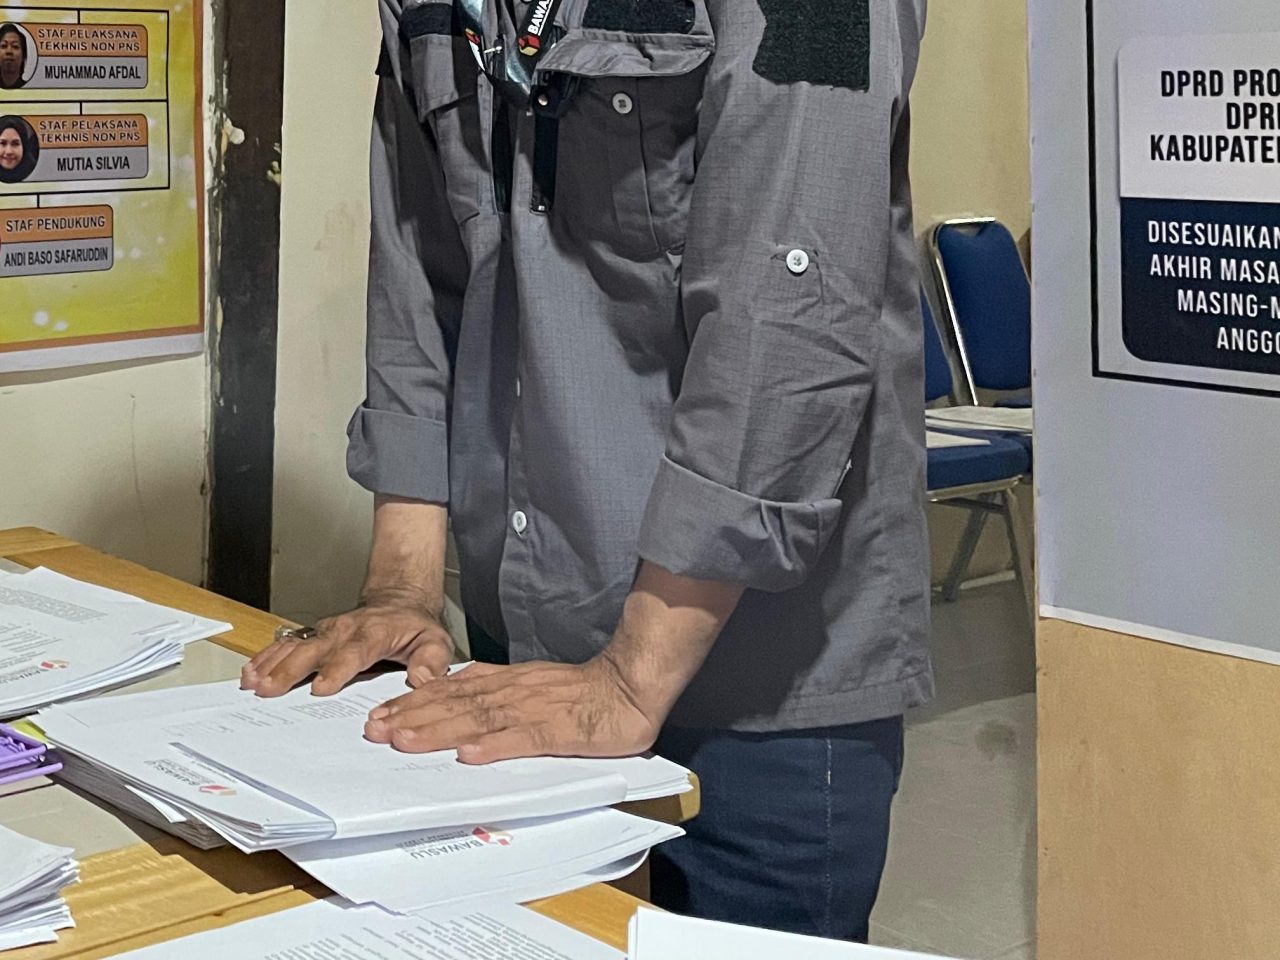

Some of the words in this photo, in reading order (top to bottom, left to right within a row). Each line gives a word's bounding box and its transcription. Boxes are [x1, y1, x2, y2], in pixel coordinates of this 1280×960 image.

[38, 28, 65, 39] STAF
[69, 29, 138, 39] PELAKSANA
[39, 41, 88, 51] TEKHNIS
[91, 42, 115, 51] NON
[118, 42, 140, 52] PNS
[44, 65, 107, 79] MUHAMMAD
[108, 65, 141, 79] AFDAL
[1161, 70, 1224, 98] DPRD
[1233, 68, 1280, 97] PRO
[39, 120, 67, 130] STAF
[71, 120, 138, 130] PELAKSANA
[40, 132, 89, 143] TEKHNIS
[92, 132, 116, 142] NON
[119, 131, 140, 141] PNS
[57, 157, 93, 171] MUTIA
[95, 155, 131, 170] SILVIA
[6, 219, 33, 232] STAF
[37, 215, 106, 230] PENDUKUNG
[4, 252, 26, 267] ANDI
[27, 250, 53, 265] BASO
[54, 247, 109, 263] SAFARUDDIN
[1150, 254, 1212, 280] AKHIR
[1220, 258, 1280, 285] MASA
[410, 839, 484, 859] BAWASLU
